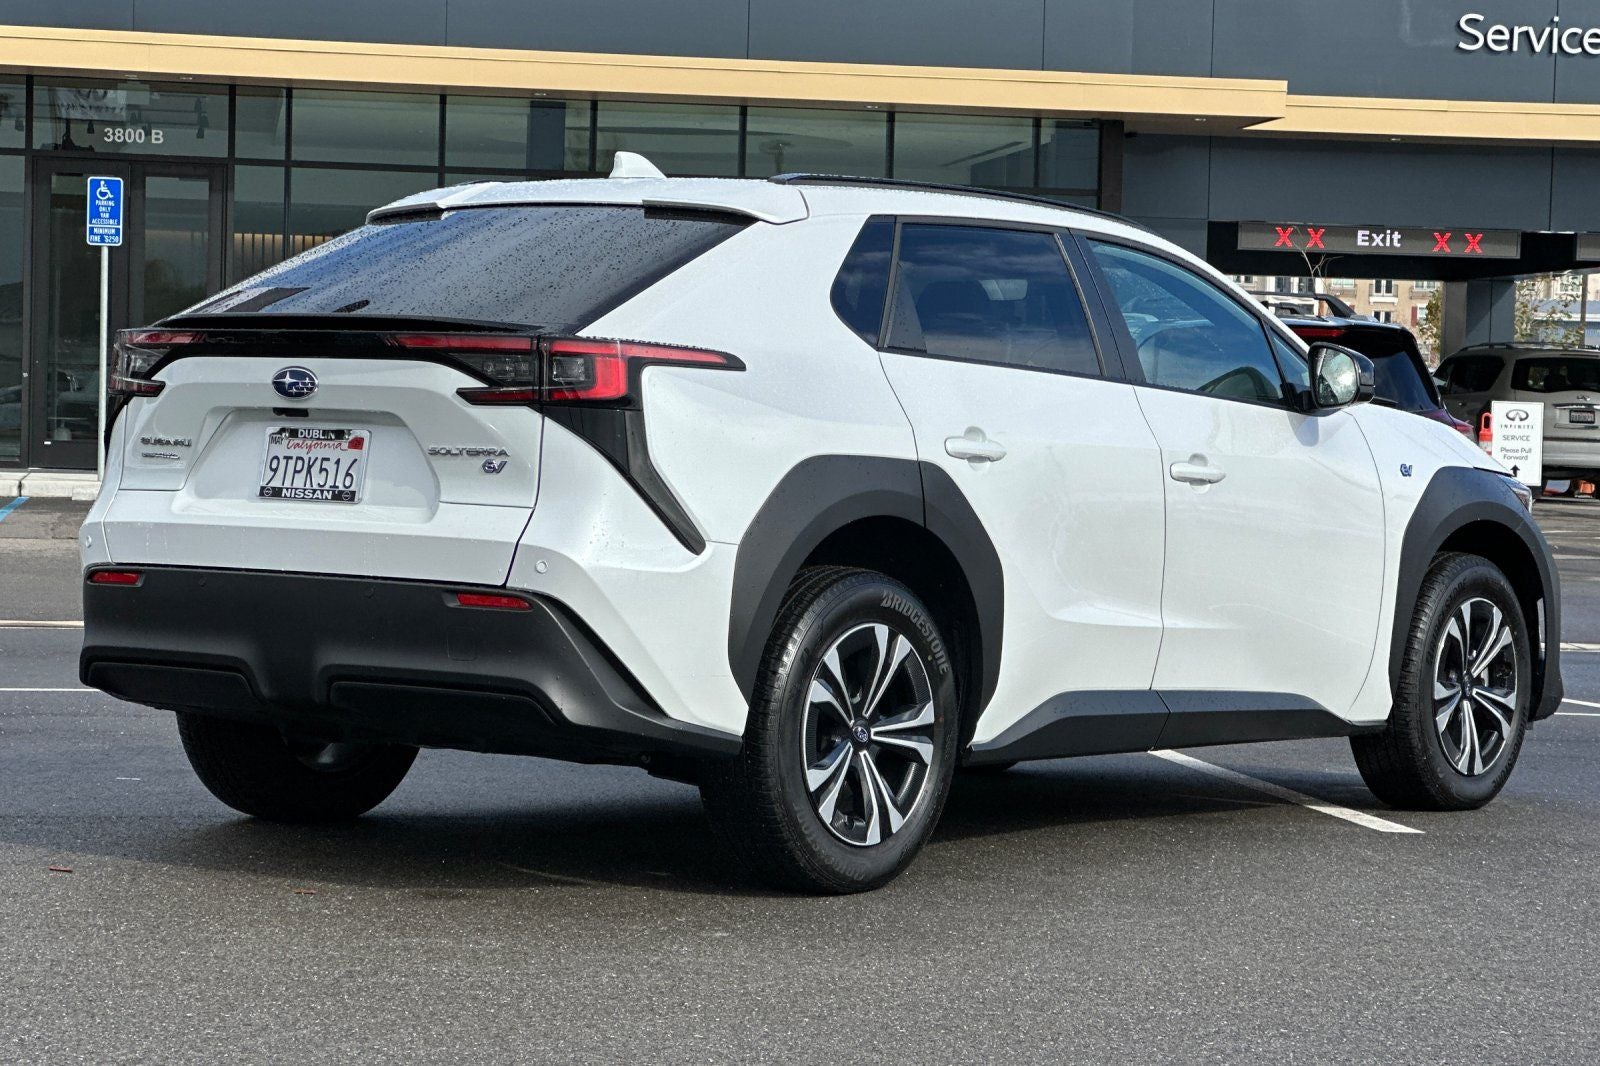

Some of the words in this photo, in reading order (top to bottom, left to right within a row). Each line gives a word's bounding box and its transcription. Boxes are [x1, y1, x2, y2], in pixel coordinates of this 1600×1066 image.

[1457, 13, 1600, 55] Service
[103, 128, 145, 144] 3800
[151, 129, 164, 144] B
[90, 234, 101, 242] FINE
[1357, 229, 1402, 248] Exit
[270, 435, 284, 445] MAY
[1502, 434, 1531, 442] SERVICE
[286, 438, 349, 455] California
[428, 446, 511, 458] SOLTERRA
[265, 455, 358, 490] 9TPK516
[281, 488, 333, 500] NISSAN
[880, 588, 950, 676] BRIDGESTONE
